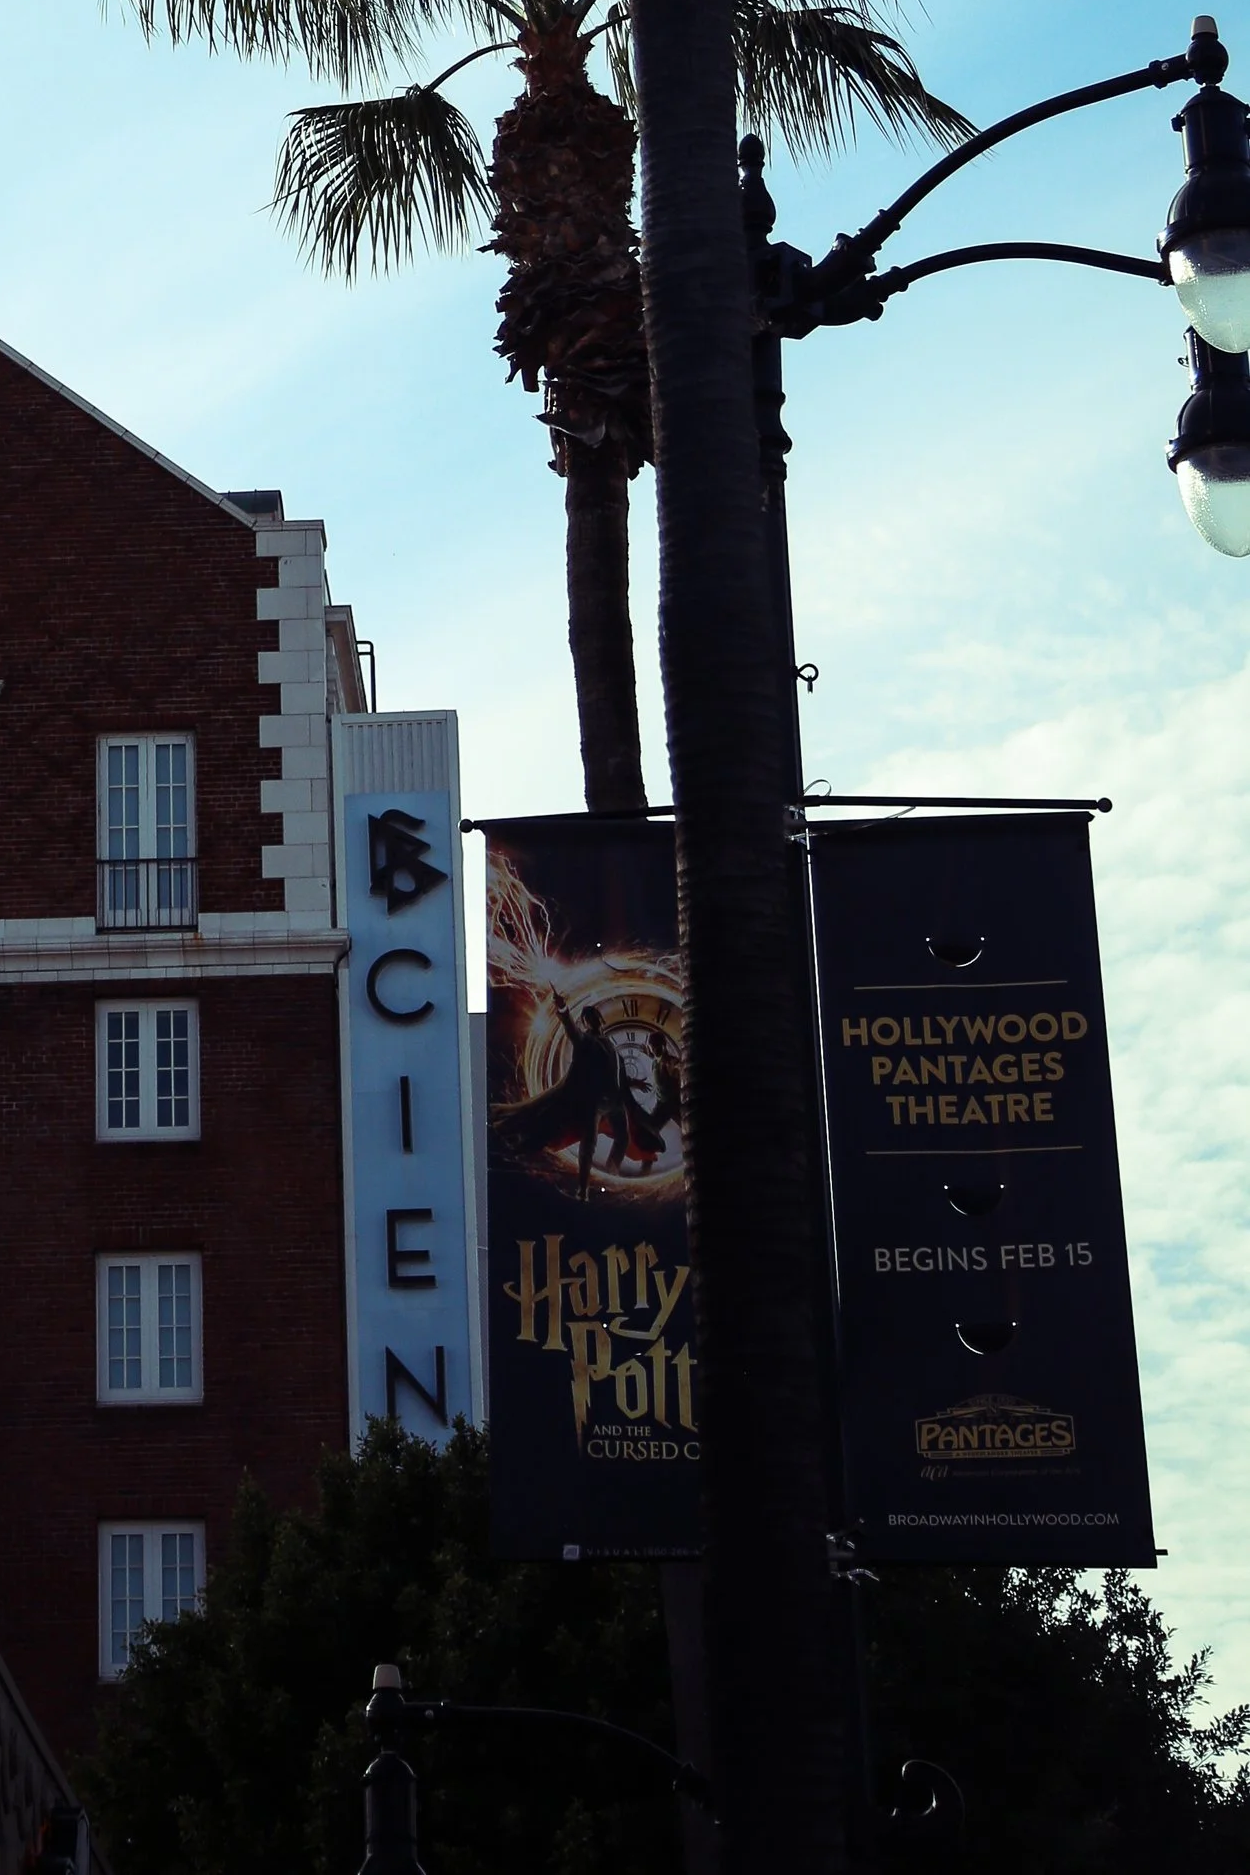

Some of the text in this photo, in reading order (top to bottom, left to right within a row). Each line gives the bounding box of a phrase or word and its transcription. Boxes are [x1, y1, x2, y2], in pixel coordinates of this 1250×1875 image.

[841, 1010, 1088, 1047] HOLLYWOOD
[871, 1051, 1065, 1085] PANTAGES
[885, 1091, 1054, 1125] THEATRE
[873, 1241, 1093, 1272] BEGINS FEB 15
[503, 1234, 690, 1352] Harry
[565, 1319, 699, 1458] Pott
[592, 1424, 652, 1437] AND THE
[920, 1420, 1072, 1450] PANTAGES
[587, 1439, 679, 1461] CURSED
[887, 1512, 1121, 1527] BROADWAYINHOLLYWOOD.COM
